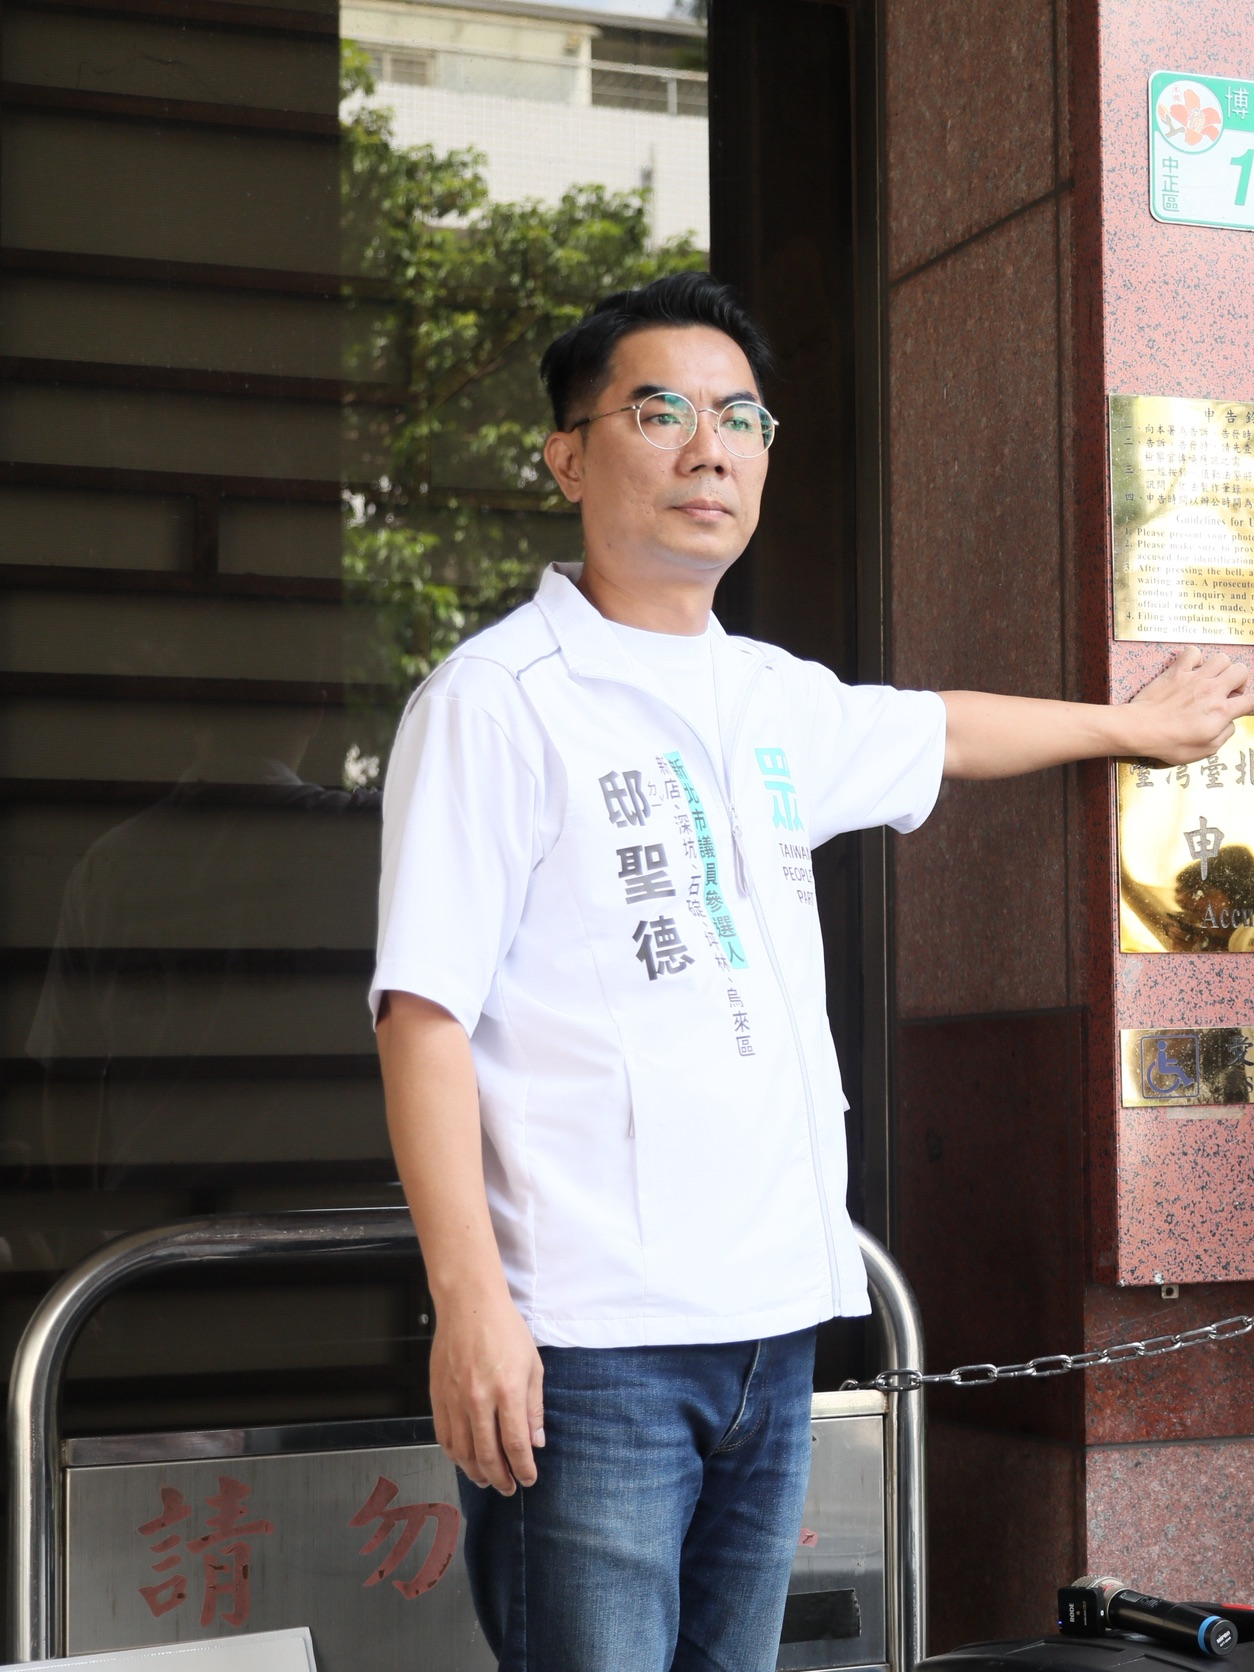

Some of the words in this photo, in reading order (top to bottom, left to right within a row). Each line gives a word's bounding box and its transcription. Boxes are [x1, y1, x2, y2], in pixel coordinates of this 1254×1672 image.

[1162, 156, 1180, 212] 中正區
[1176, 514, 1226, 525] Guidelines
[1230, 517, 1244, 527] for
[1137, 528, 1165, 537] Please
[1169, 531, 1202, 540] present
[1207, 532, 1227, 541] your
[1124, 540, 1133, 548] 2.
[1137, 540, 1165, 549] Please
[1170, 542, 1193, 550] make
[1221, 544, 1230, 552] to
[1137, 553, 1172, 561] accused
[1194, 555, 1254, 565] identification
[1124, 564, 1133, 572] 3.
[1137, 564, 1161, 573] After
[1165, 566, 1203, 576] pressing
[1207, 567, 1222, 575] the
[1225, 568, 1245, 577] bell,
[1137, 576, 1171, 586] waiting
[1137, 588, 1173, 597] conduct
[1193, 590, 1226, 601] inquiry
[1230, 592, 1247, 600] and
[1137, 601, 1170, 609] official
[1174, 602, 1204, 611] record
[1208, 603, 1216, 611] is
[1219, 604, 1247, 613] made,
[1126, 611, 1135, 620] 4.
[1138, 612, 1165, 622] Filing
[1168, 614, 1224, 623] complaint(s)
[1228, 616, 1237, 624] in
[1137, 624, 1168, 634] during
[1172, 626, 1198, 634] office
[1202, 627, 1225, 635] hour.
[1228, 627, 1245, 635] The
[668, 758, 745, 964] 新北市議員參選人
[598, 769, 696, 982] 邸聖德
[782, 866, 813, 883] PEOPLE
[797, 889, 814, 906] PART
[136, 1474, 461, 1627] 請勿
